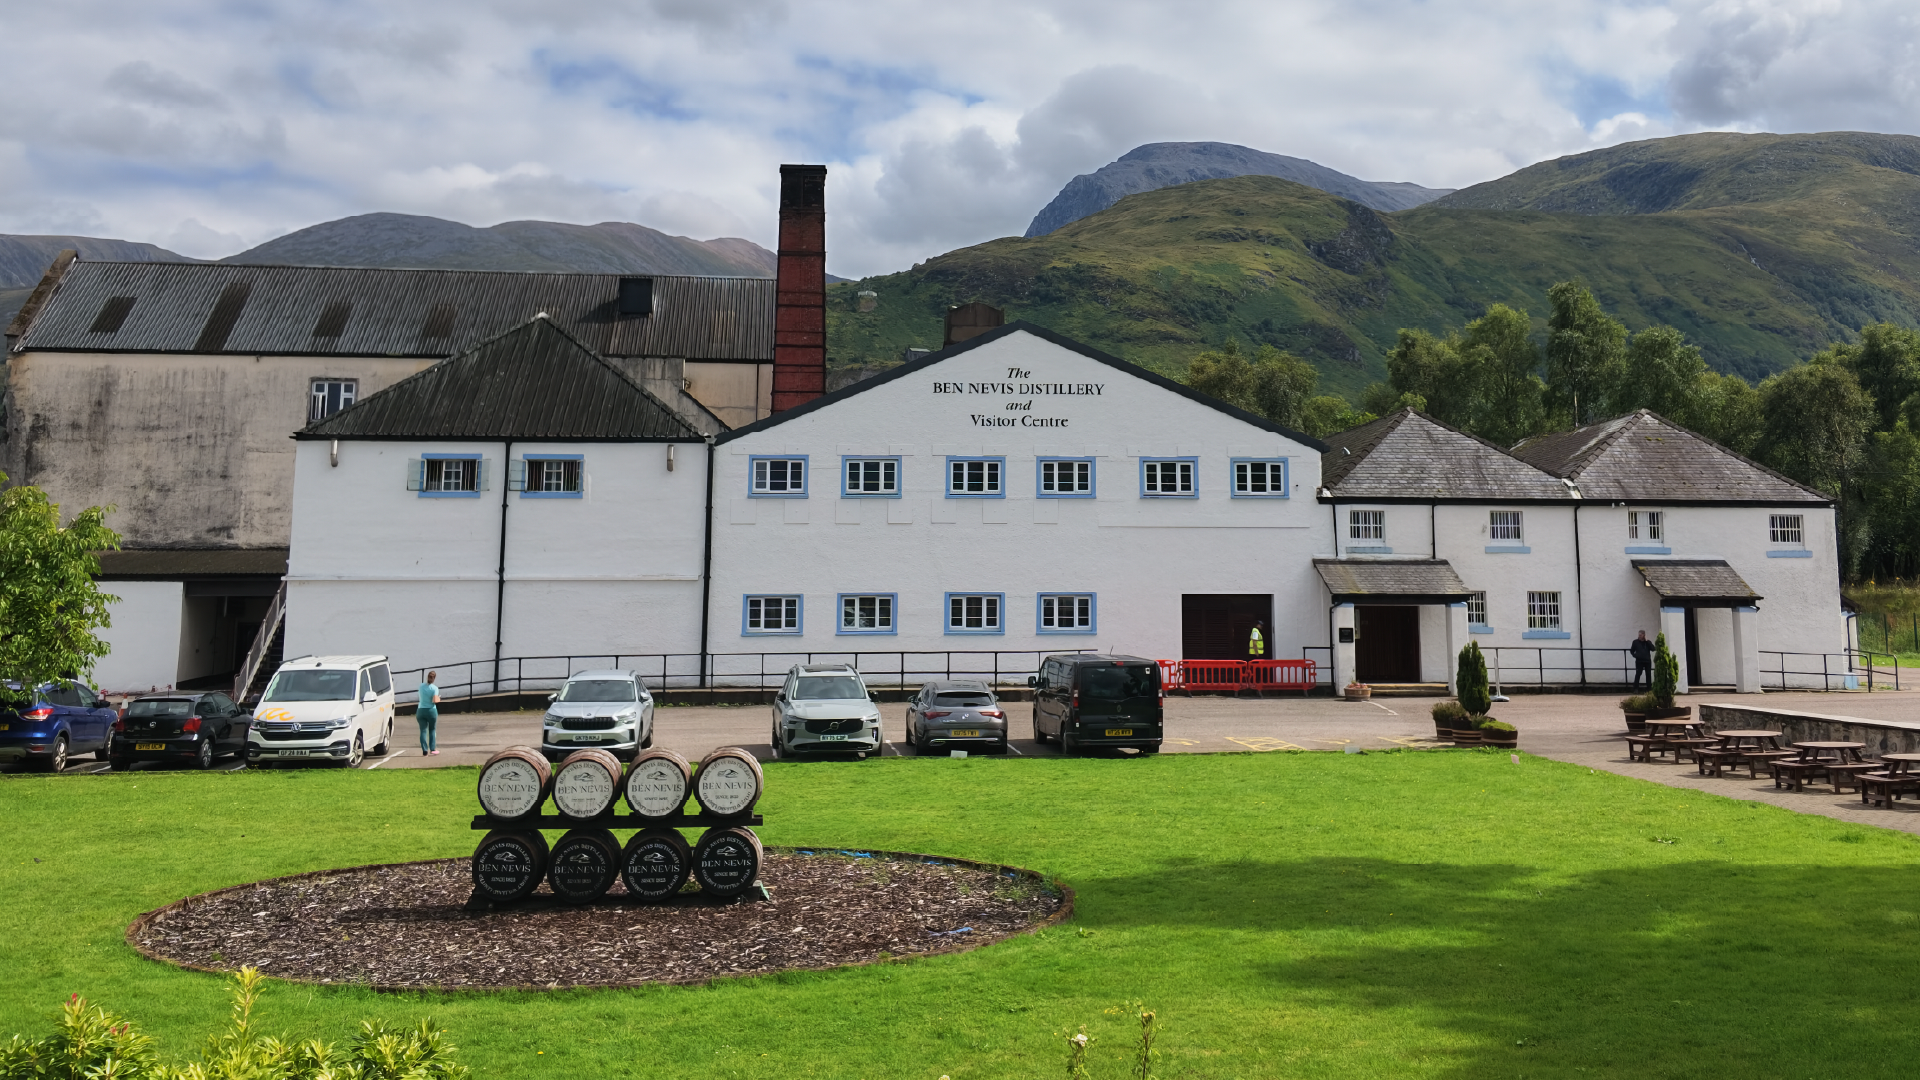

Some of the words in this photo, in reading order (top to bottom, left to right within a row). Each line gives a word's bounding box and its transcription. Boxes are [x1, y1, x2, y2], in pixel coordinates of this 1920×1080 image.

[1007, 367, 1031, 379] The
[933, 382, 963, 394] BEN
[968, 382, 1014, 395] NEVIS
[1019, 383, 1105, 395] DISTILLERY
[1005, 400, 1033, 411] and
[970, 414, 1017, 427] Visitor
[1021, 414, 1069, 428] Centre
[484, 784, 505, 793] BEN
[507, 784, 537, 792] NEVIS
[558, 786, 578, 794] BEN
[580, 785, 610, 793] NEVIS
[631, 784, 651, 793] BEN
[653, 784, 682, 792] NEVIS
[702, 782, 721, 790] BEN
[723, 782, 753, 790] NEVIS
[701, 859, 721, 868] BEN
[723, 859, 752, 867] NEVIS
[478, 864, 499, 872] BEN
[501, 864, 531, 873] NEVIS
[554, 865, 574, 874] BEN
[576, 865, 606, 874] NEVIS
[628, 865, 648, 874] BEN
[650, 865, 680, 873] NEVIS
